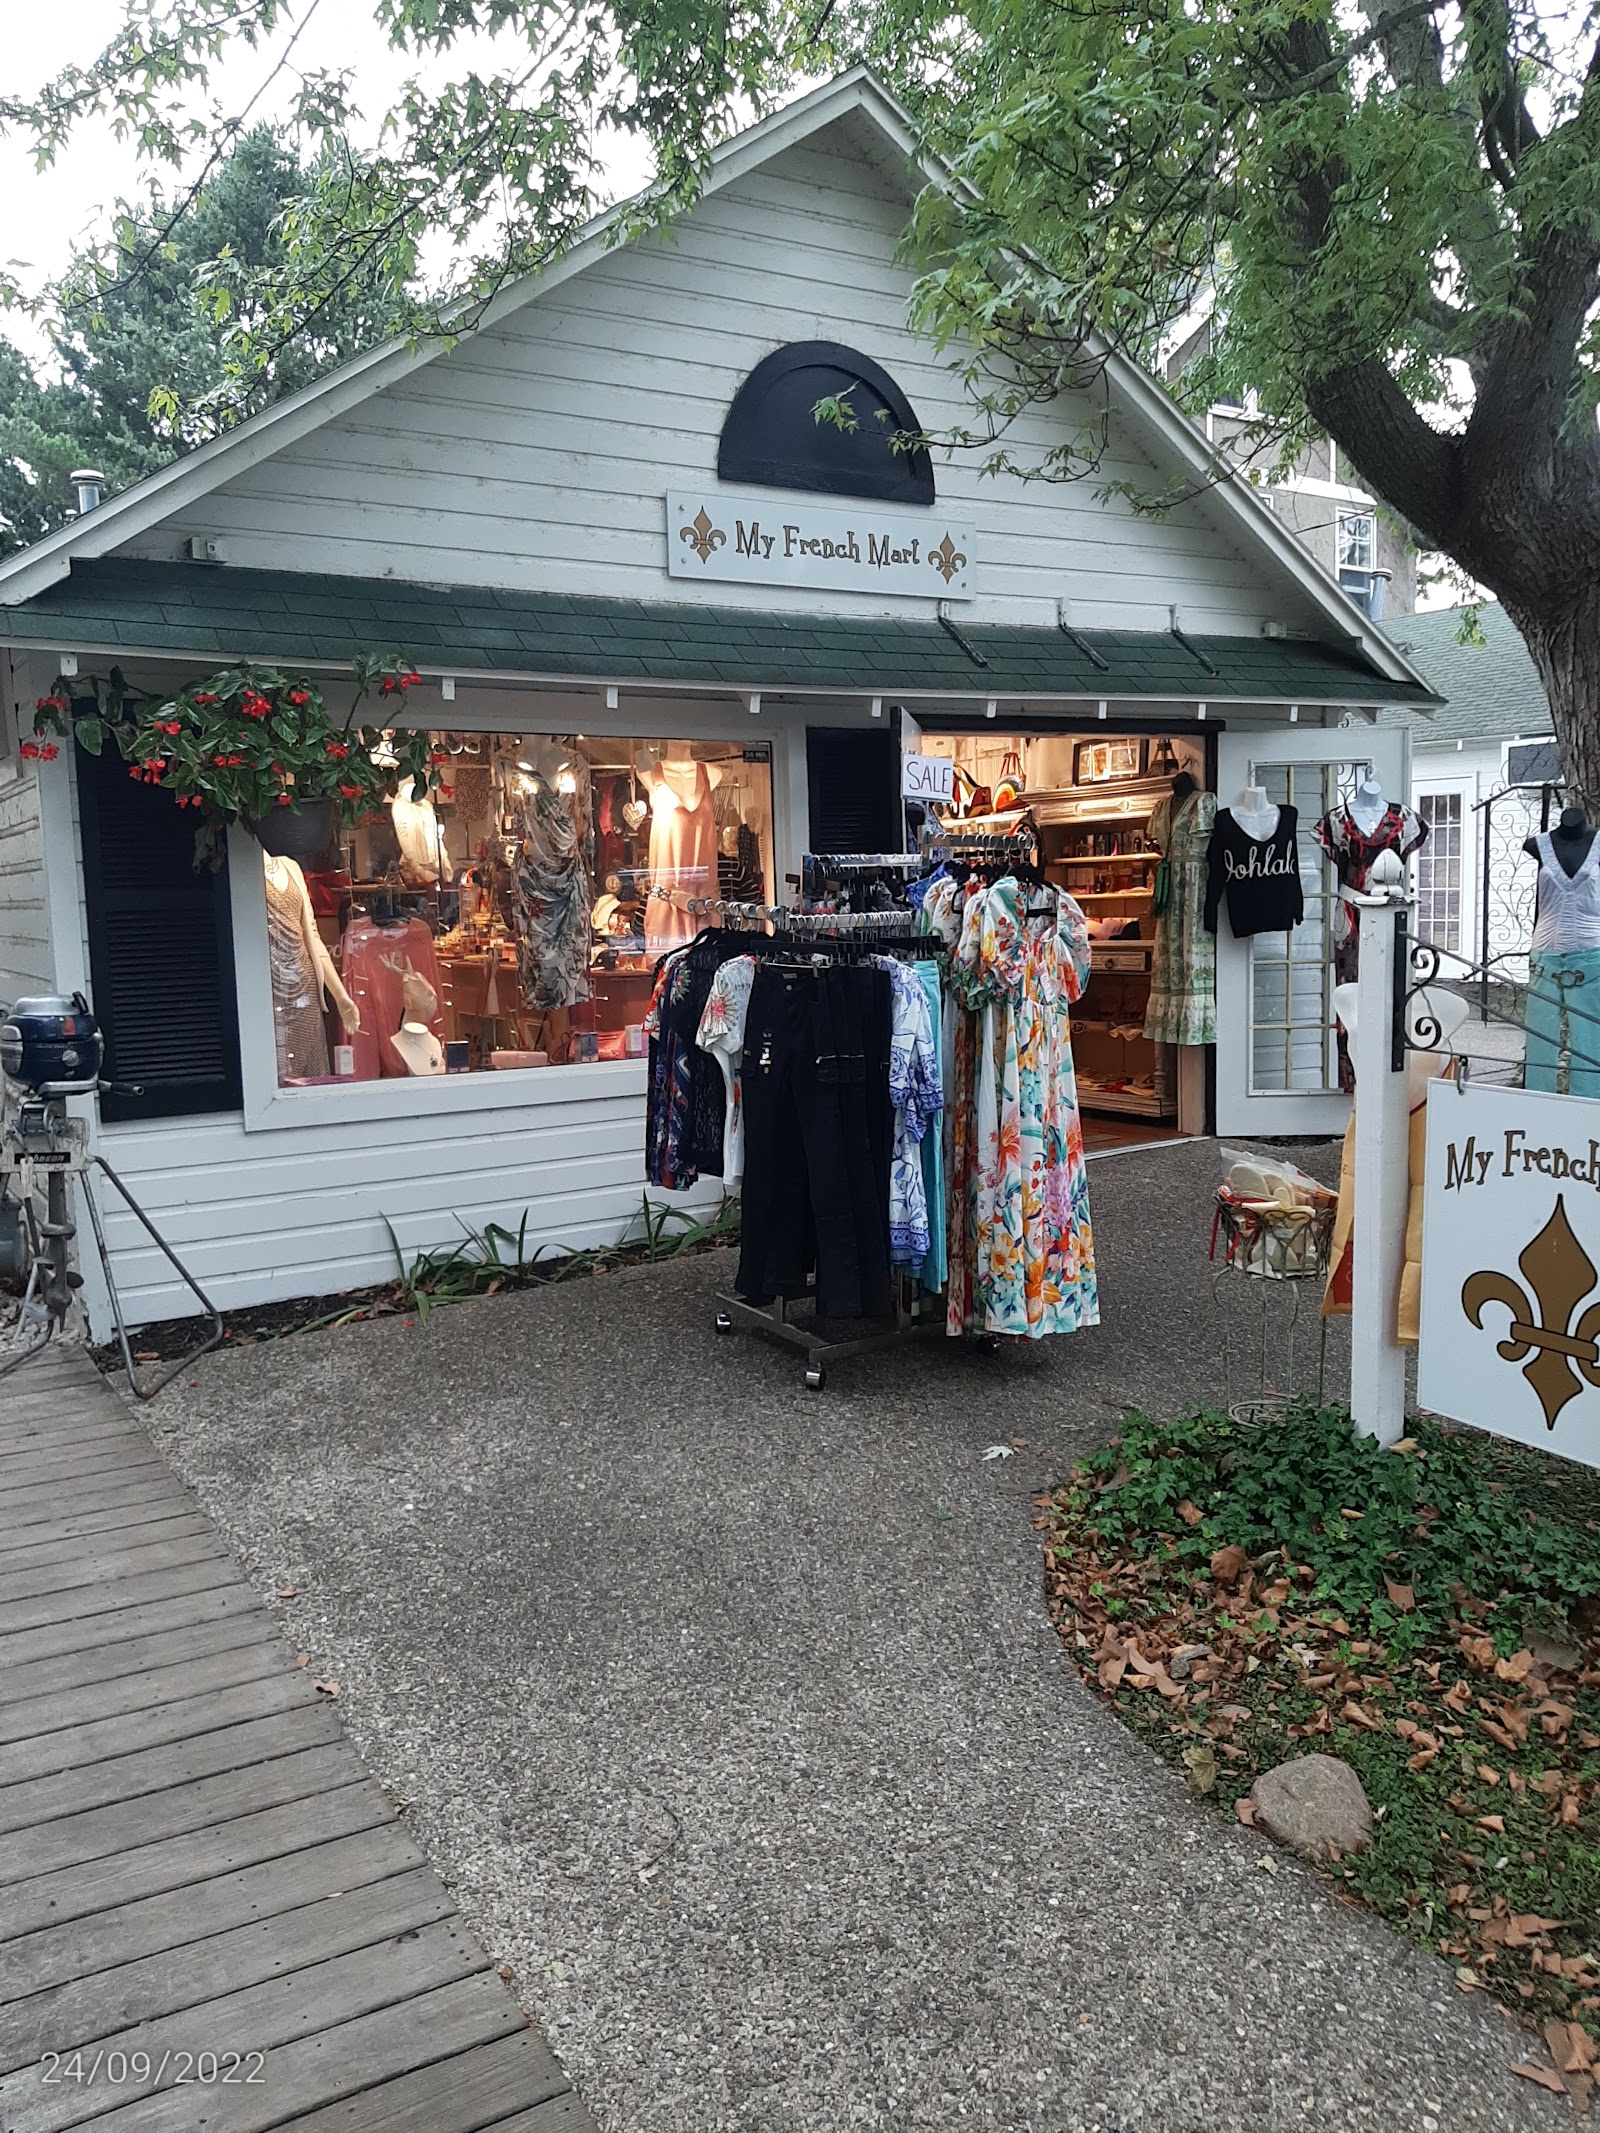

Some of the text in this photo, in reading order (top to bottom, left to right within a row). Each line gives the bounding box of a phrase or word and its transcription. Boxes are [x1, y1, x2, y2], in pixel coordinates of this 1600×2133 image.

[735, 520, 920, 571] My French Mart
[906, 761, 951, 794] SALE
[1444, 1130, 1600, 1194] My French
